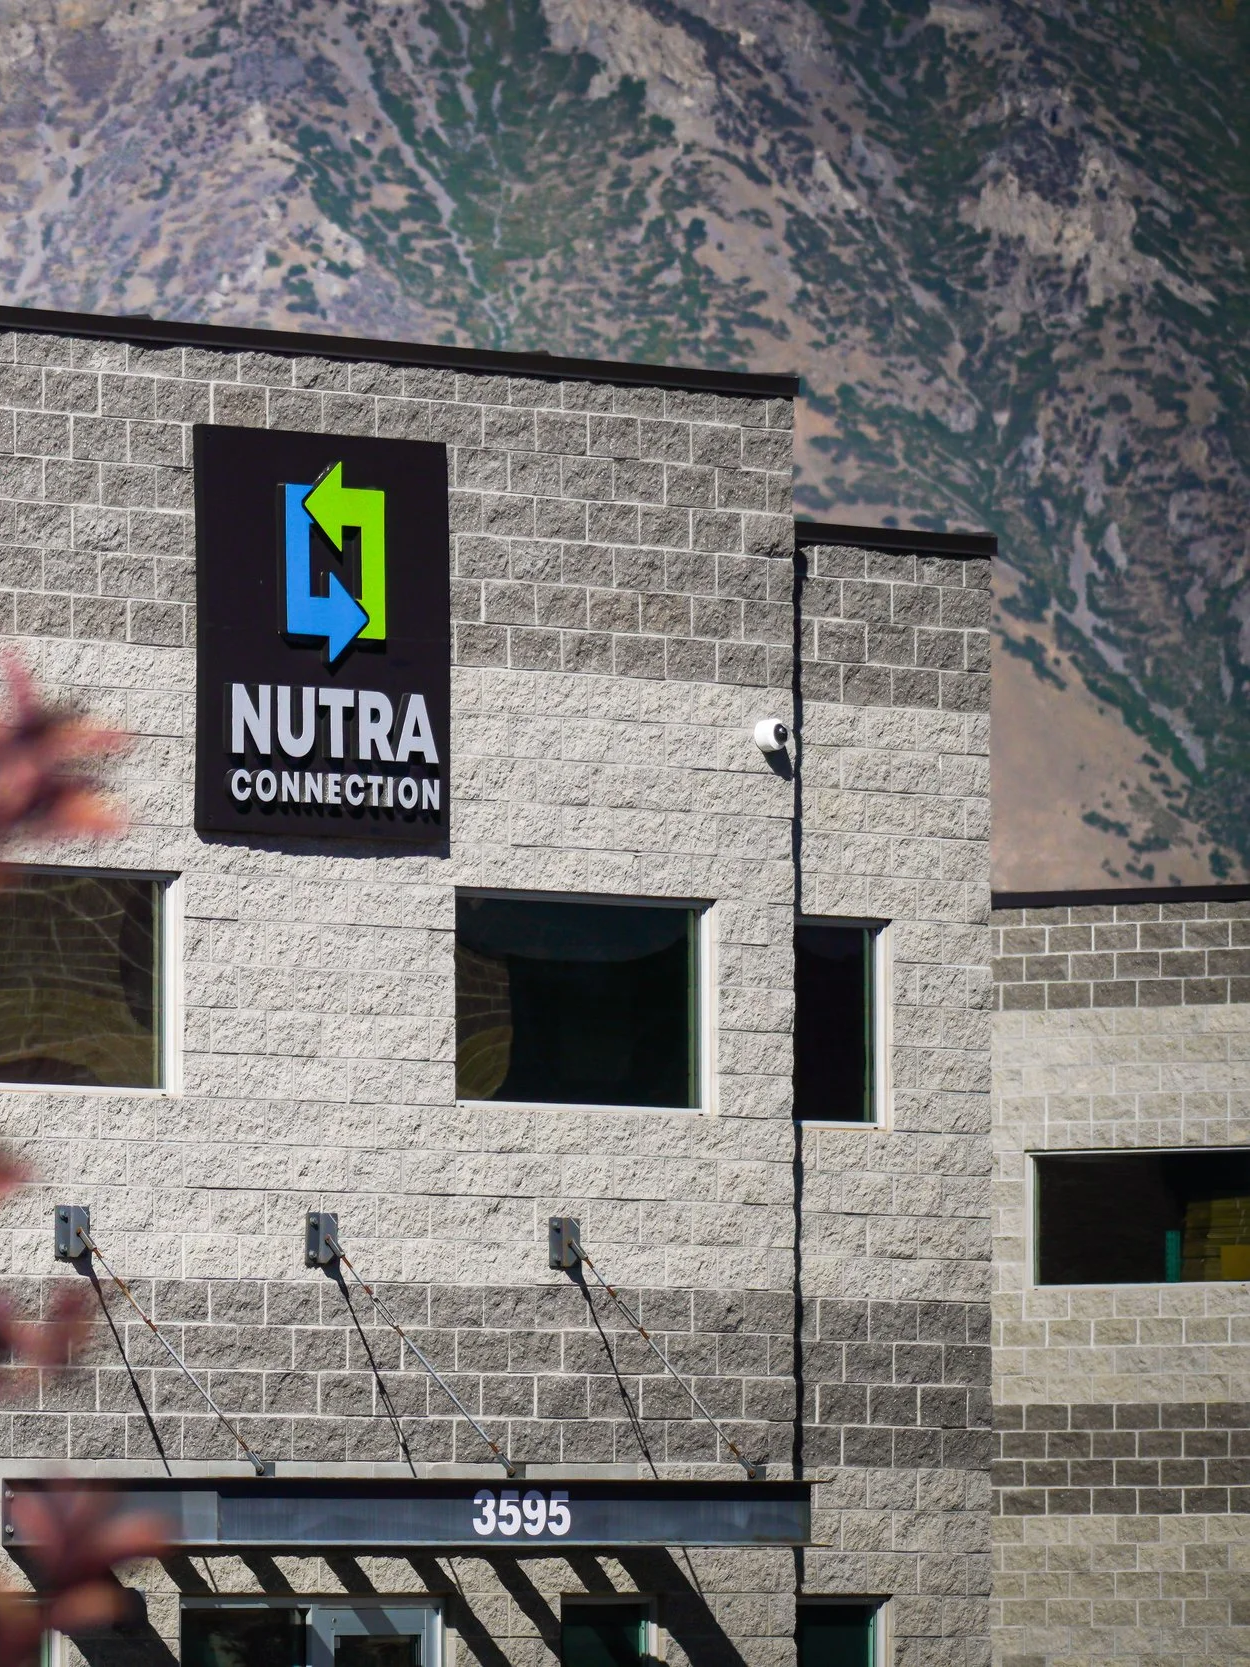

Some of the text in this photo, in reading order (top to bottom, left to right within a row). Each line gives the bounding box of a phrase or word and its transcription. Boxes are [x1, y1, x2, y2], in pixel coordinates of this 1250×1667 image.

[231, 683, 440, 763] NUTRA
[231, 769, 440, 810] CONNECTION
[472, 1490, 571, 1536] 3595
